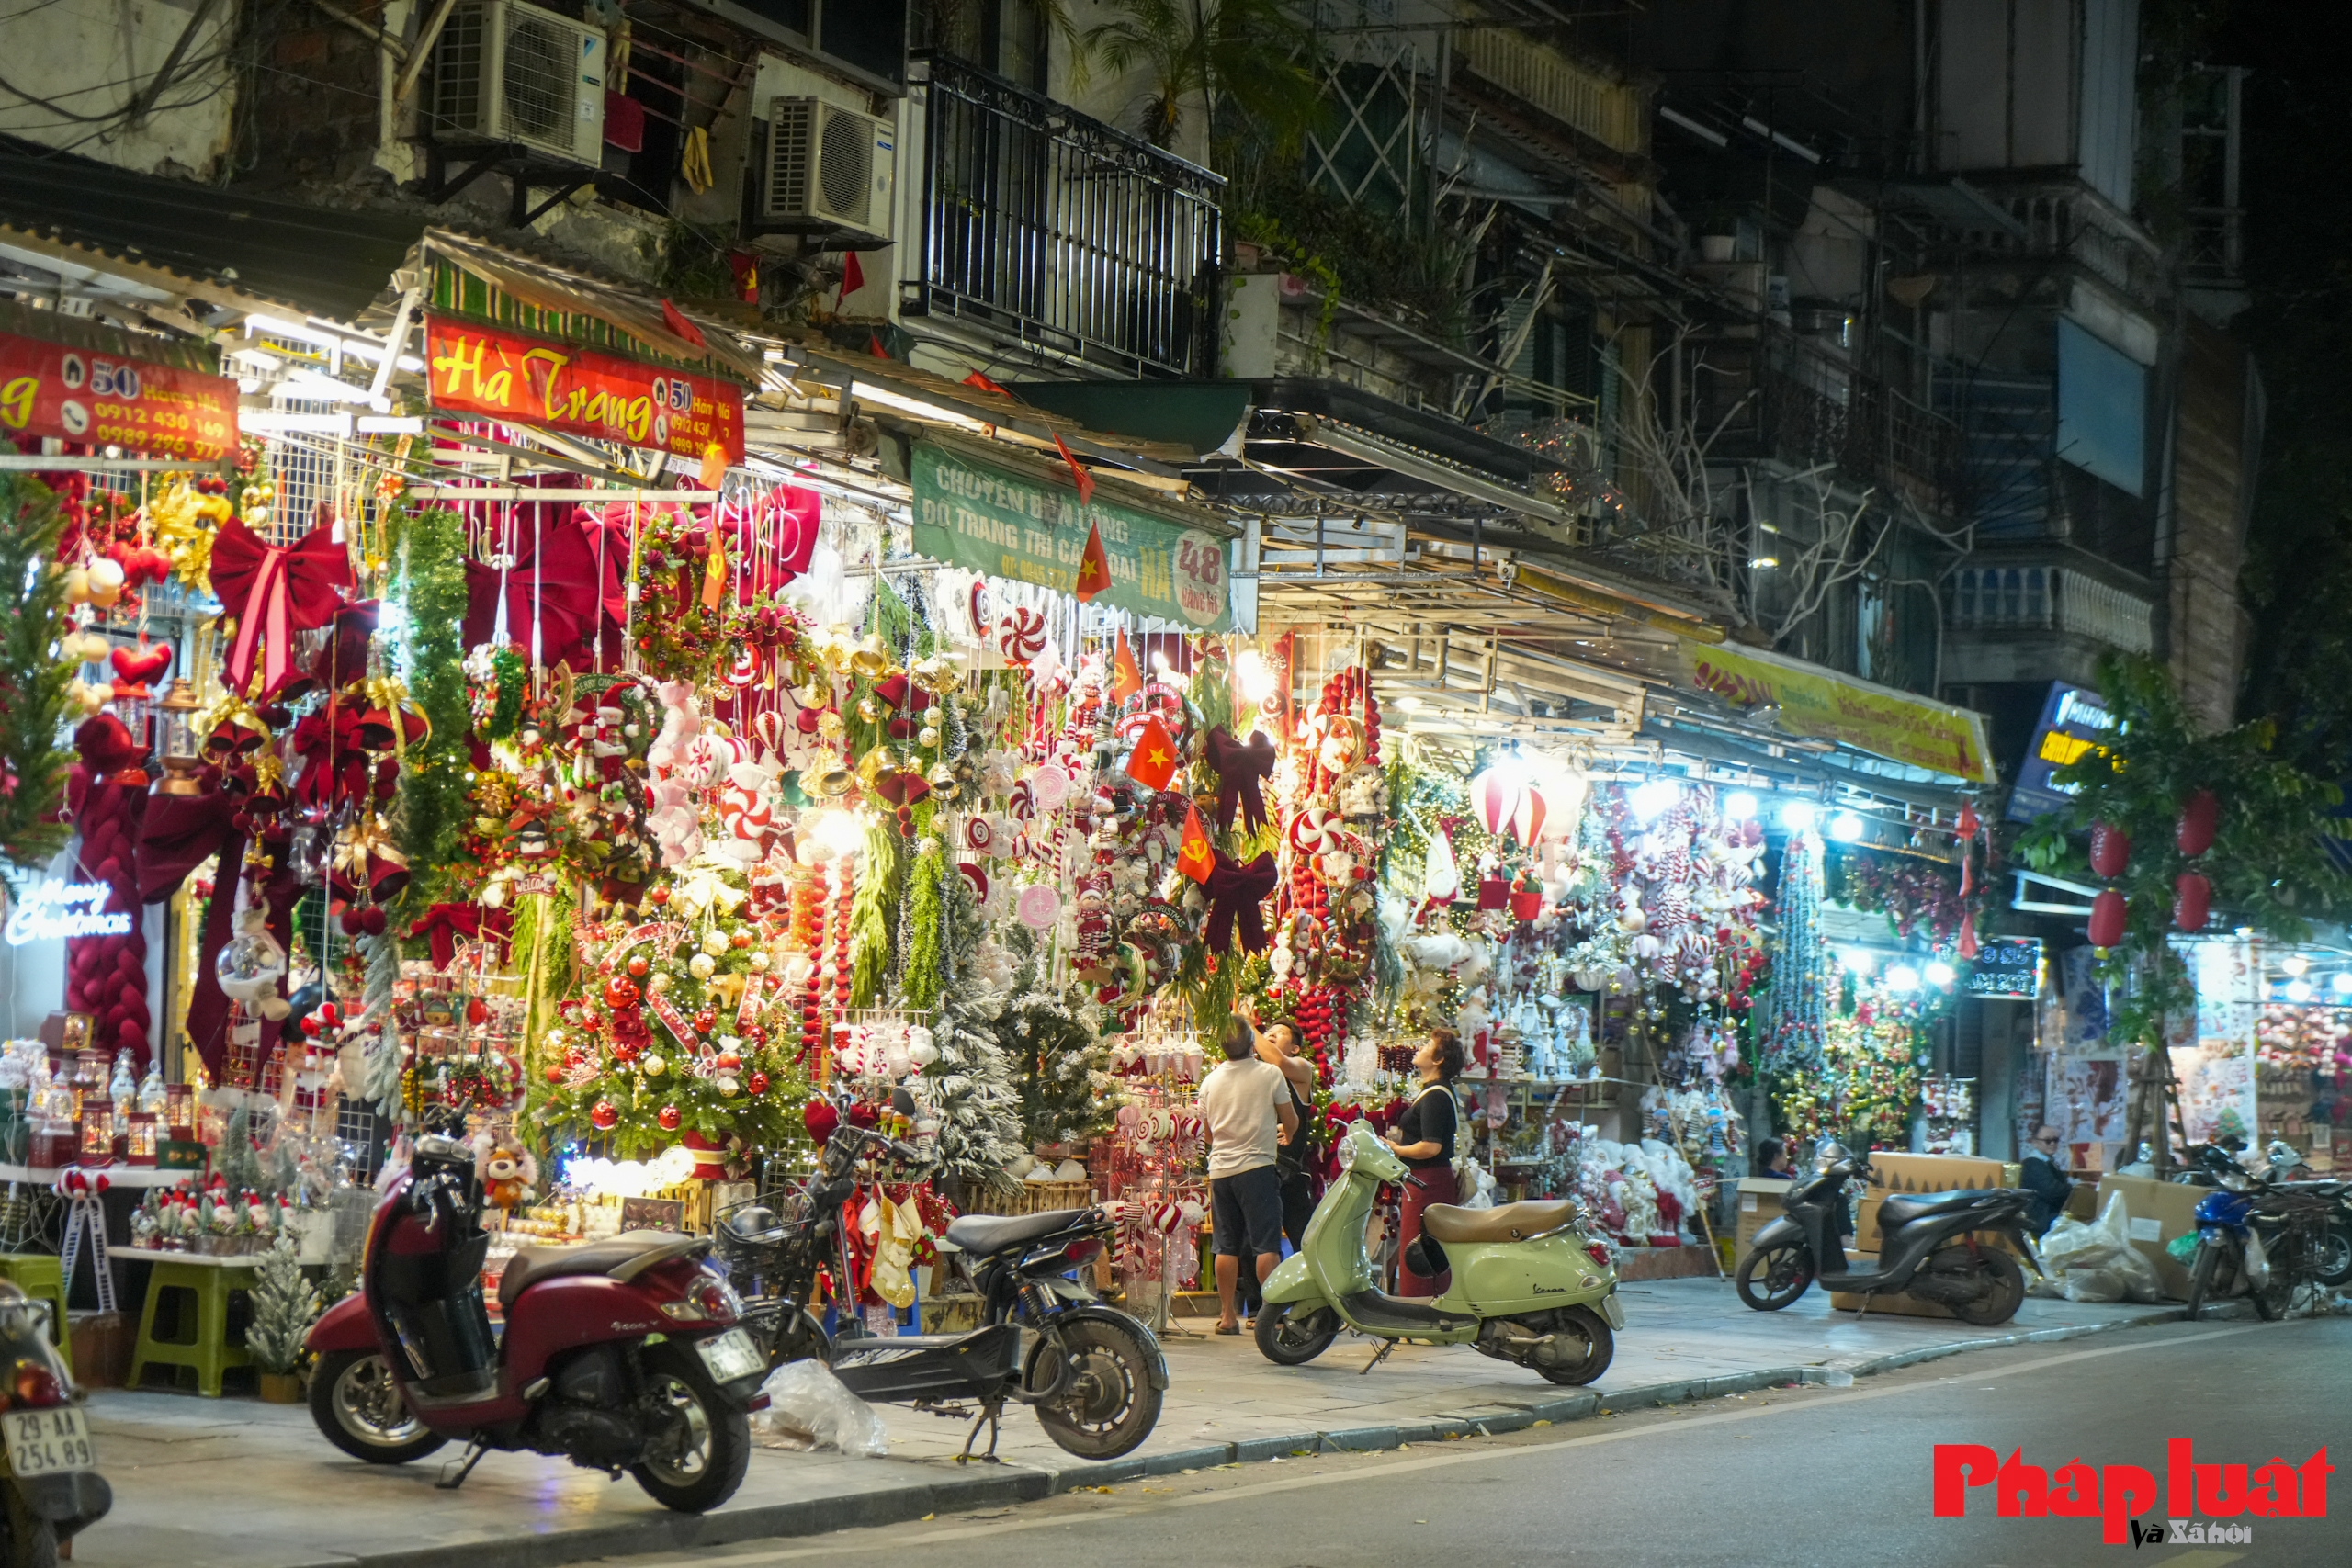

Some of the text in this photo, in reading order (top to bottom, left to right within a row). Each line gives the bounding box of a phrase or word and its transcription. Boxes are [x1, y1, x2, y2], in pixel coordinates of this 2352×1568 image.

[90, 358, 140, 400] 50
[432, 335, 652, 443] Hà Trang
[670, 378, 692, 412] 50
[95, 403, 225, 438] 0912 430 169
[671, 413, 692, 434] 0912
[96, 424, 147, 446] 0989
[152, 433, 187, 453] 296
[670, 435, 692, 453] 0989
[935, 465, 1024, 514] CHUYÊN
[956, 507, 1018, 549] TRANG
[1024, 529, 1053, 559] TRÍ
[1057, 537, 1085, 567] CÁ
[1107, 552, 1136, 584] OẠI
[1139, 539, 1170, 603] HÀ
[1179, 539, 1220, 585] 48
[1182, 583, 1205, 612] HÀNG
[573, 679, 595, 695] MERRY
[1159, 684, 1178, 701] SNOW
[1156, 793, 1171, 803] HO!
[18, 877, 112, 914] Merry
[514, 876, 552, 895] WELCOME
[6, 905, 132, 946] Christmas
[1149, 902, 1186, 929] CHRISTMAS
[1532, 1282, 1567, 1295] Vespa
